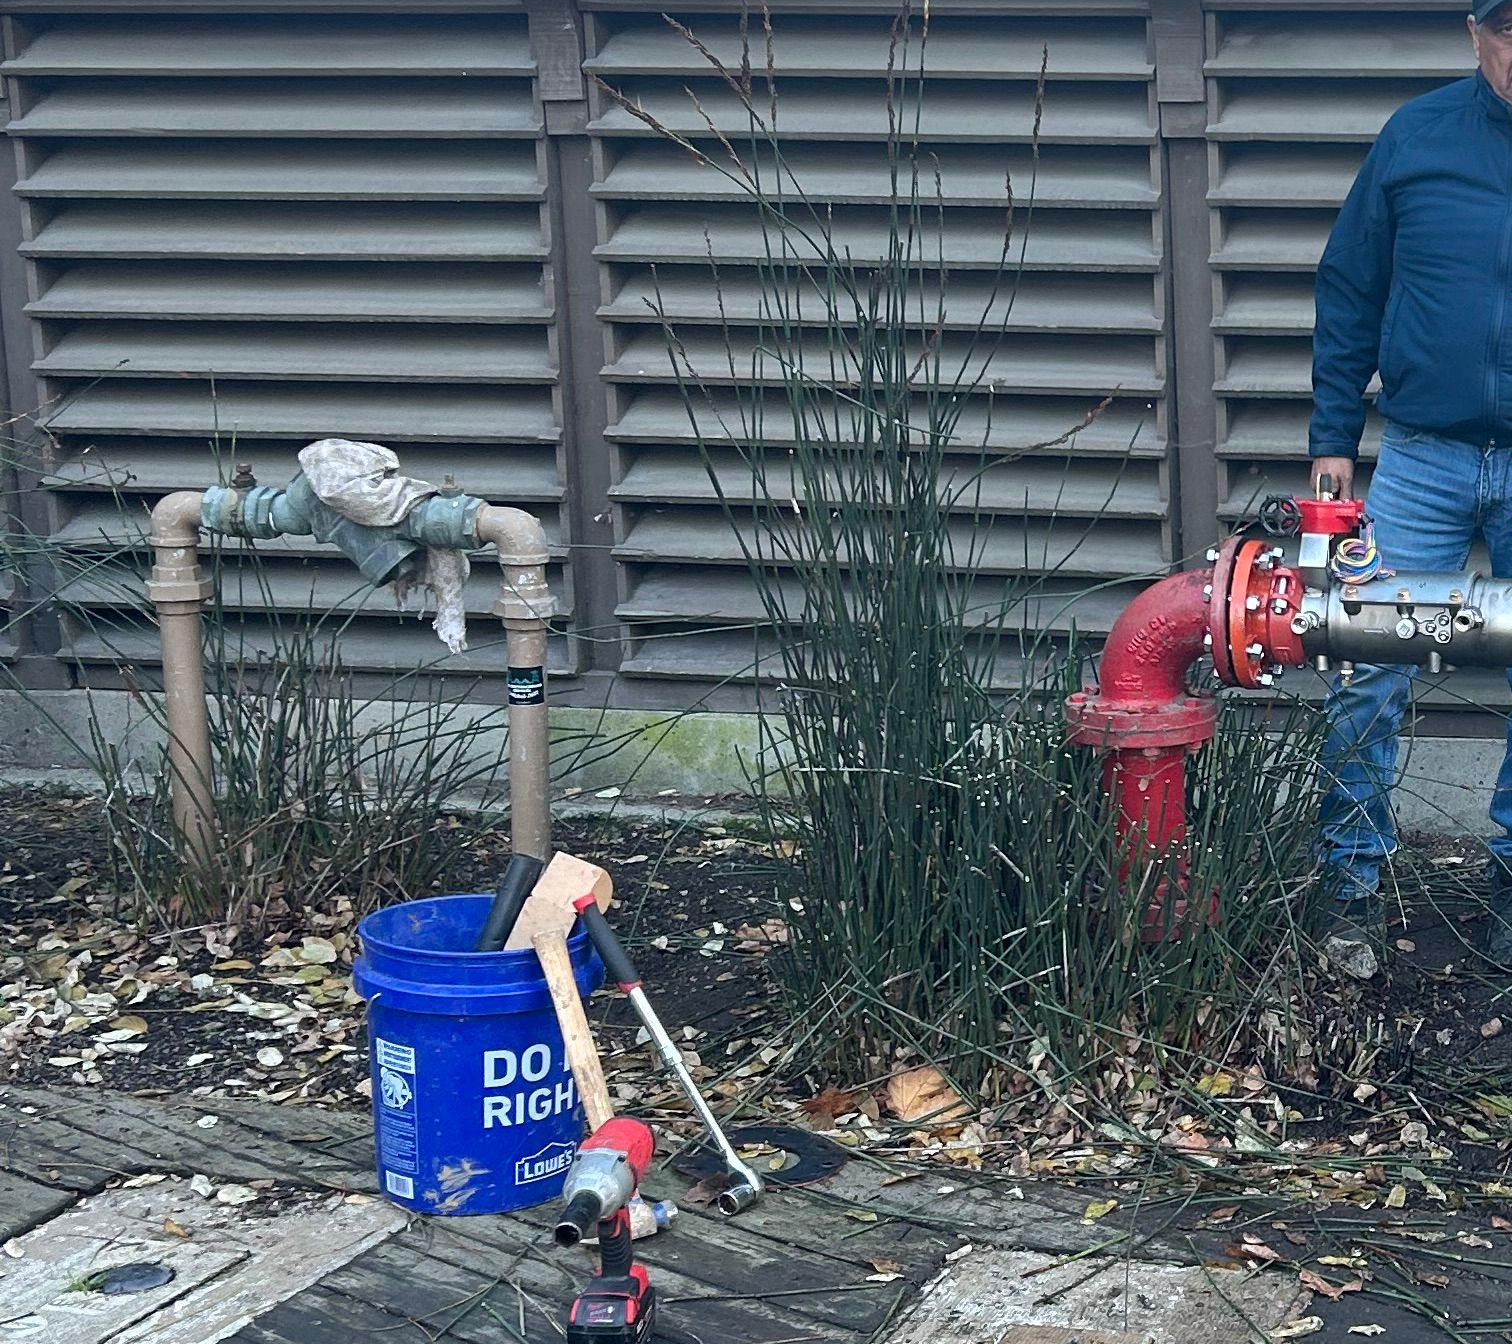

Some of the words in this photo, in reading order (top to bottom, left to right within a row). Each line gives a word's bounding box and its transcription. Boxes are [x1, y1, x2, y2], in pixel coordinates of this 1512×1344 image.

[484, 1043, 551, 1088] DO
[484, 1078, 581, 1128] RIGH
[523, 1149, 574, 1180] LOWE'S
